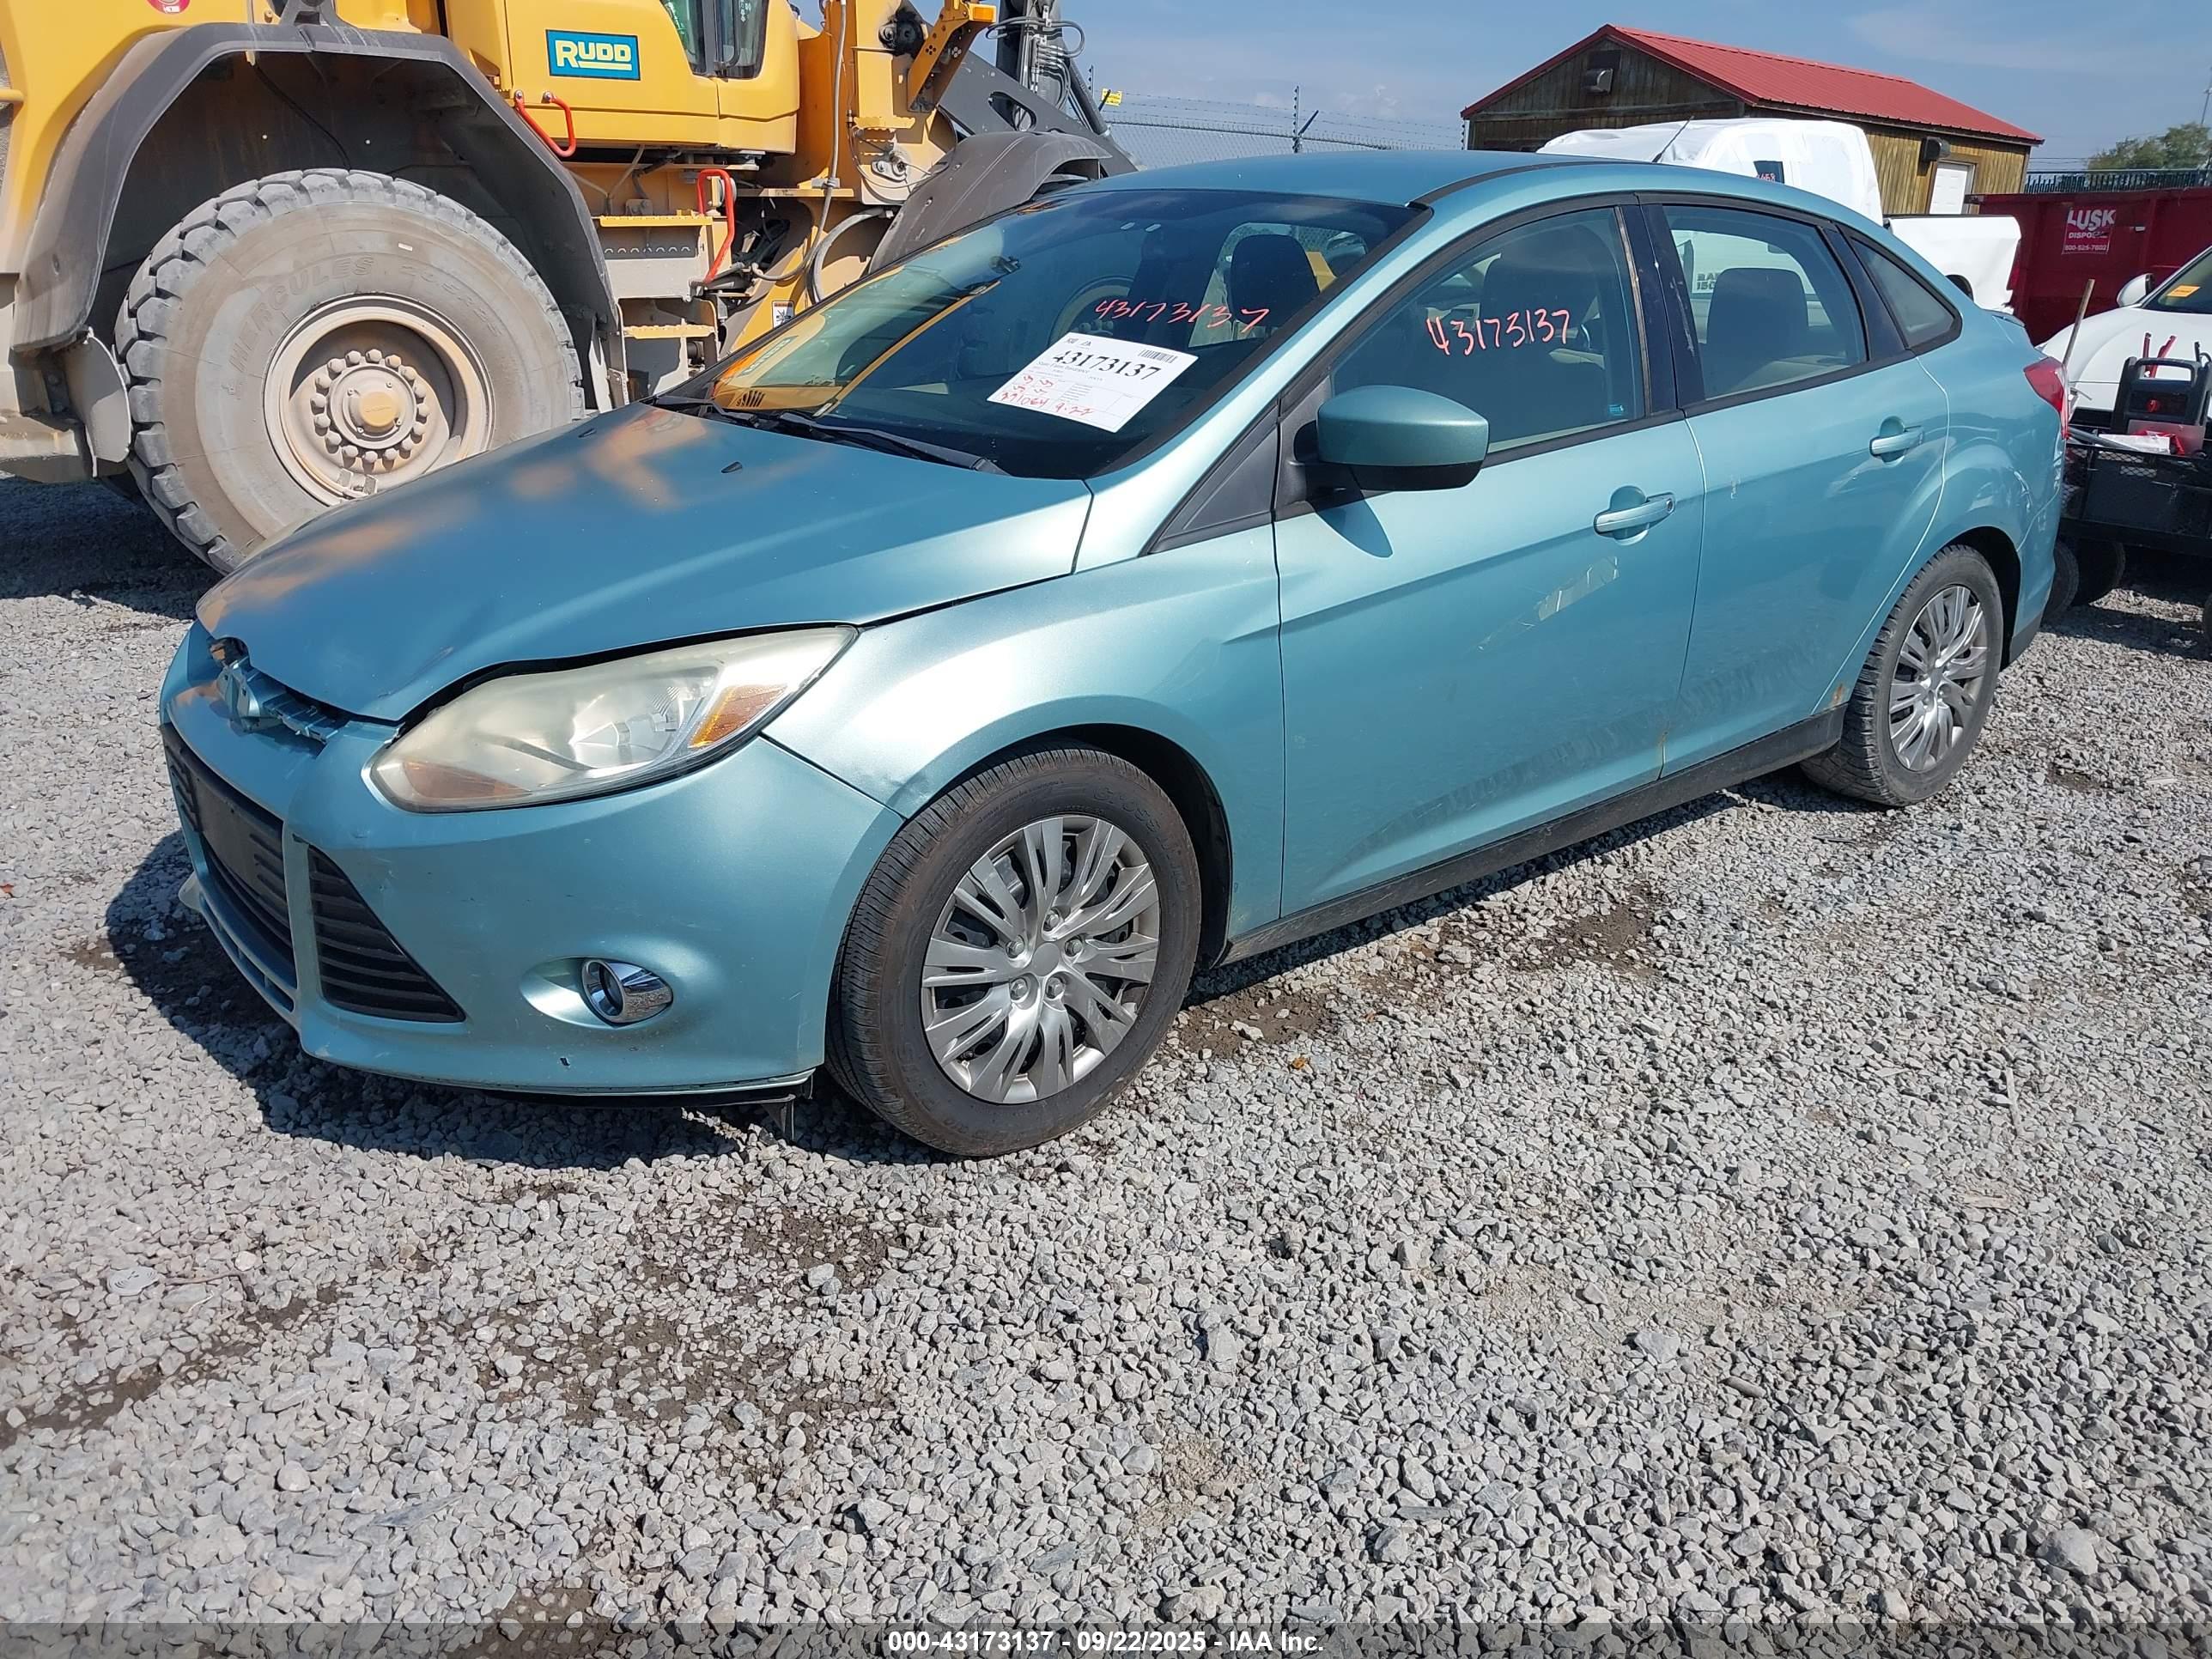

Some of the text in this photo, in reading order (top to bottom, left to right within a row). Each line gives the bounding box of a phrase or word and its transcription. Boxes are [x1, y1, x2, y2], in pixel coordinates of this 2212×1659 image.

[555, 40, 631, 69] RUDD
[2067, 210, 2116, 231] LUSK
[1095, 299, 1269, 333] 43173137
[1426, 308, 1570, 356] 43173137
[1053, 350, 1162, 380] 43173137
